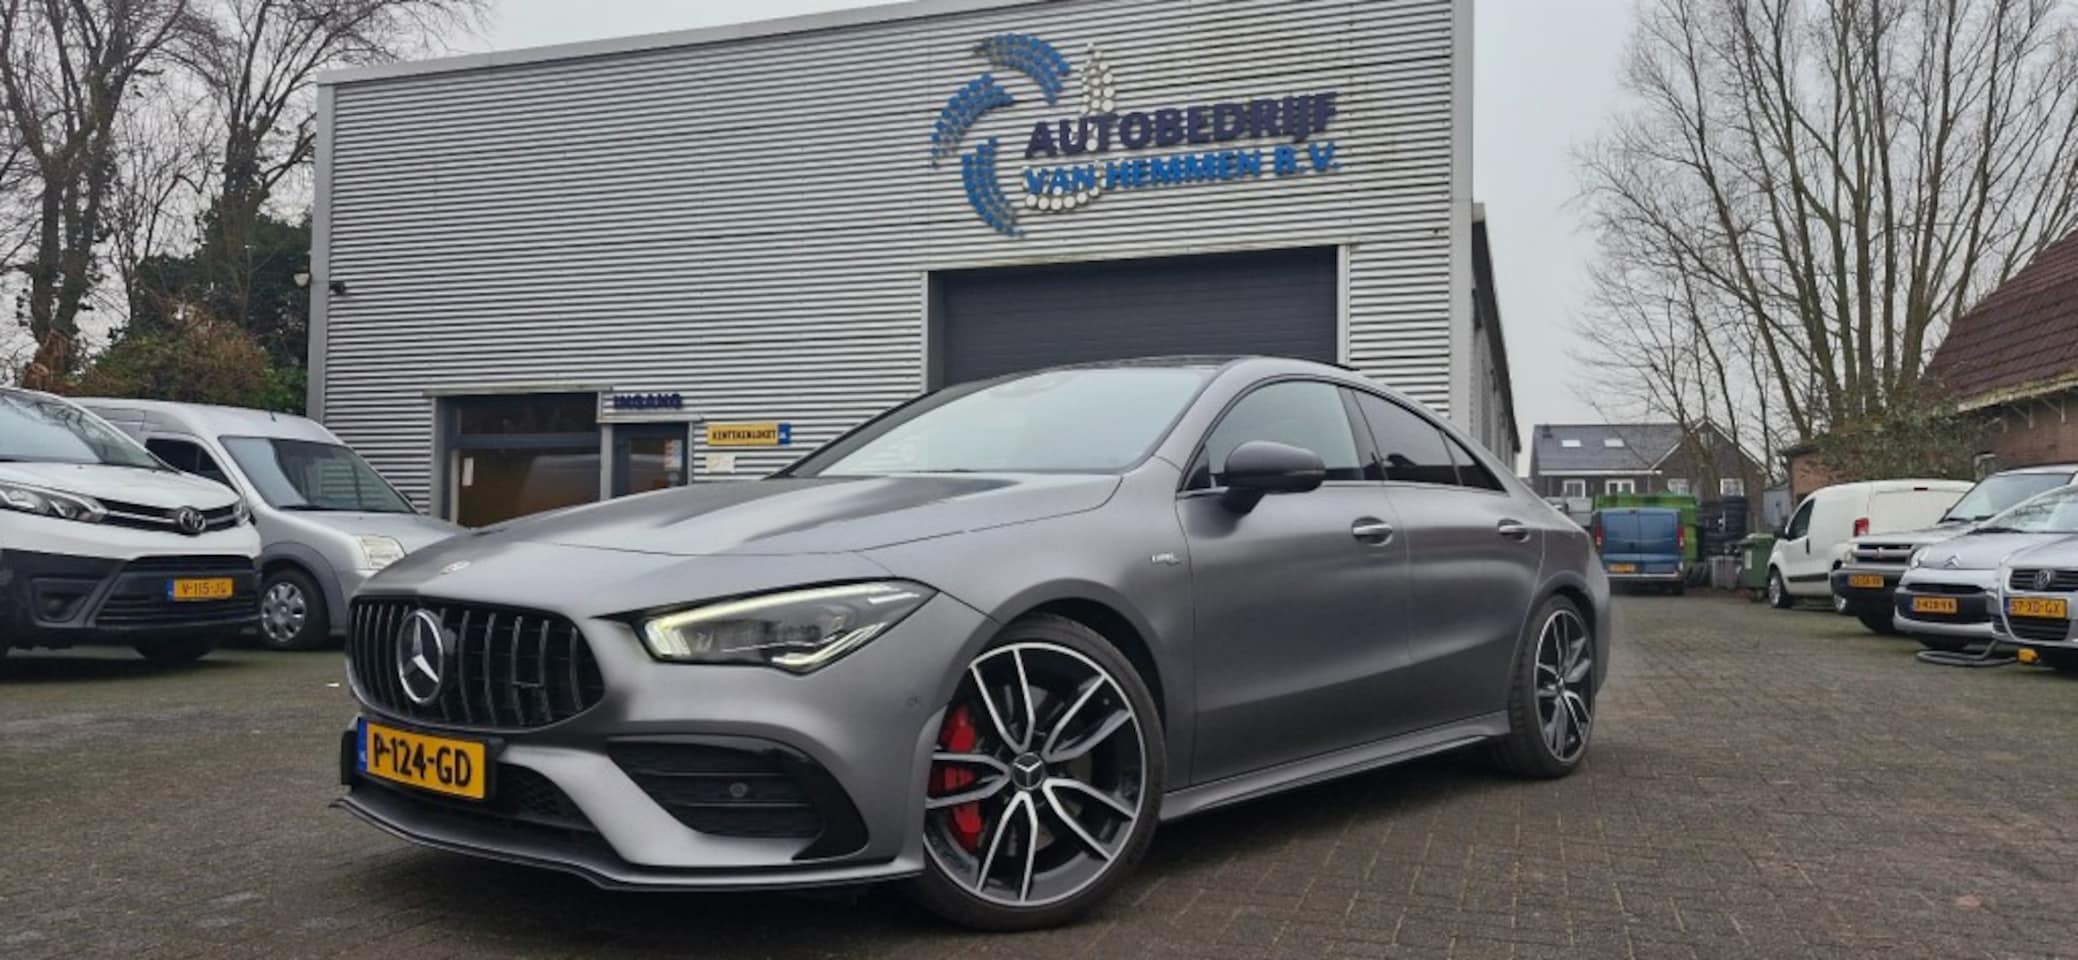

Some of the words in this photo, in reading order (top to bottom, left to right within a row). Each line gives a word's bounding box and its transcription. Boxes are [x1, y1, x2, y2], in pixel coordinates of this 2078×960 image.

[1025, 92, 1338, 159] AUTOBEDRIJF
[1024, 164, 1097, 195] VAN
[1104, 151, 1263, 190] HEMMEN
[1274, 141, 1341, 176] B.V.
[373, 732, 472, 788] P-124-GD
